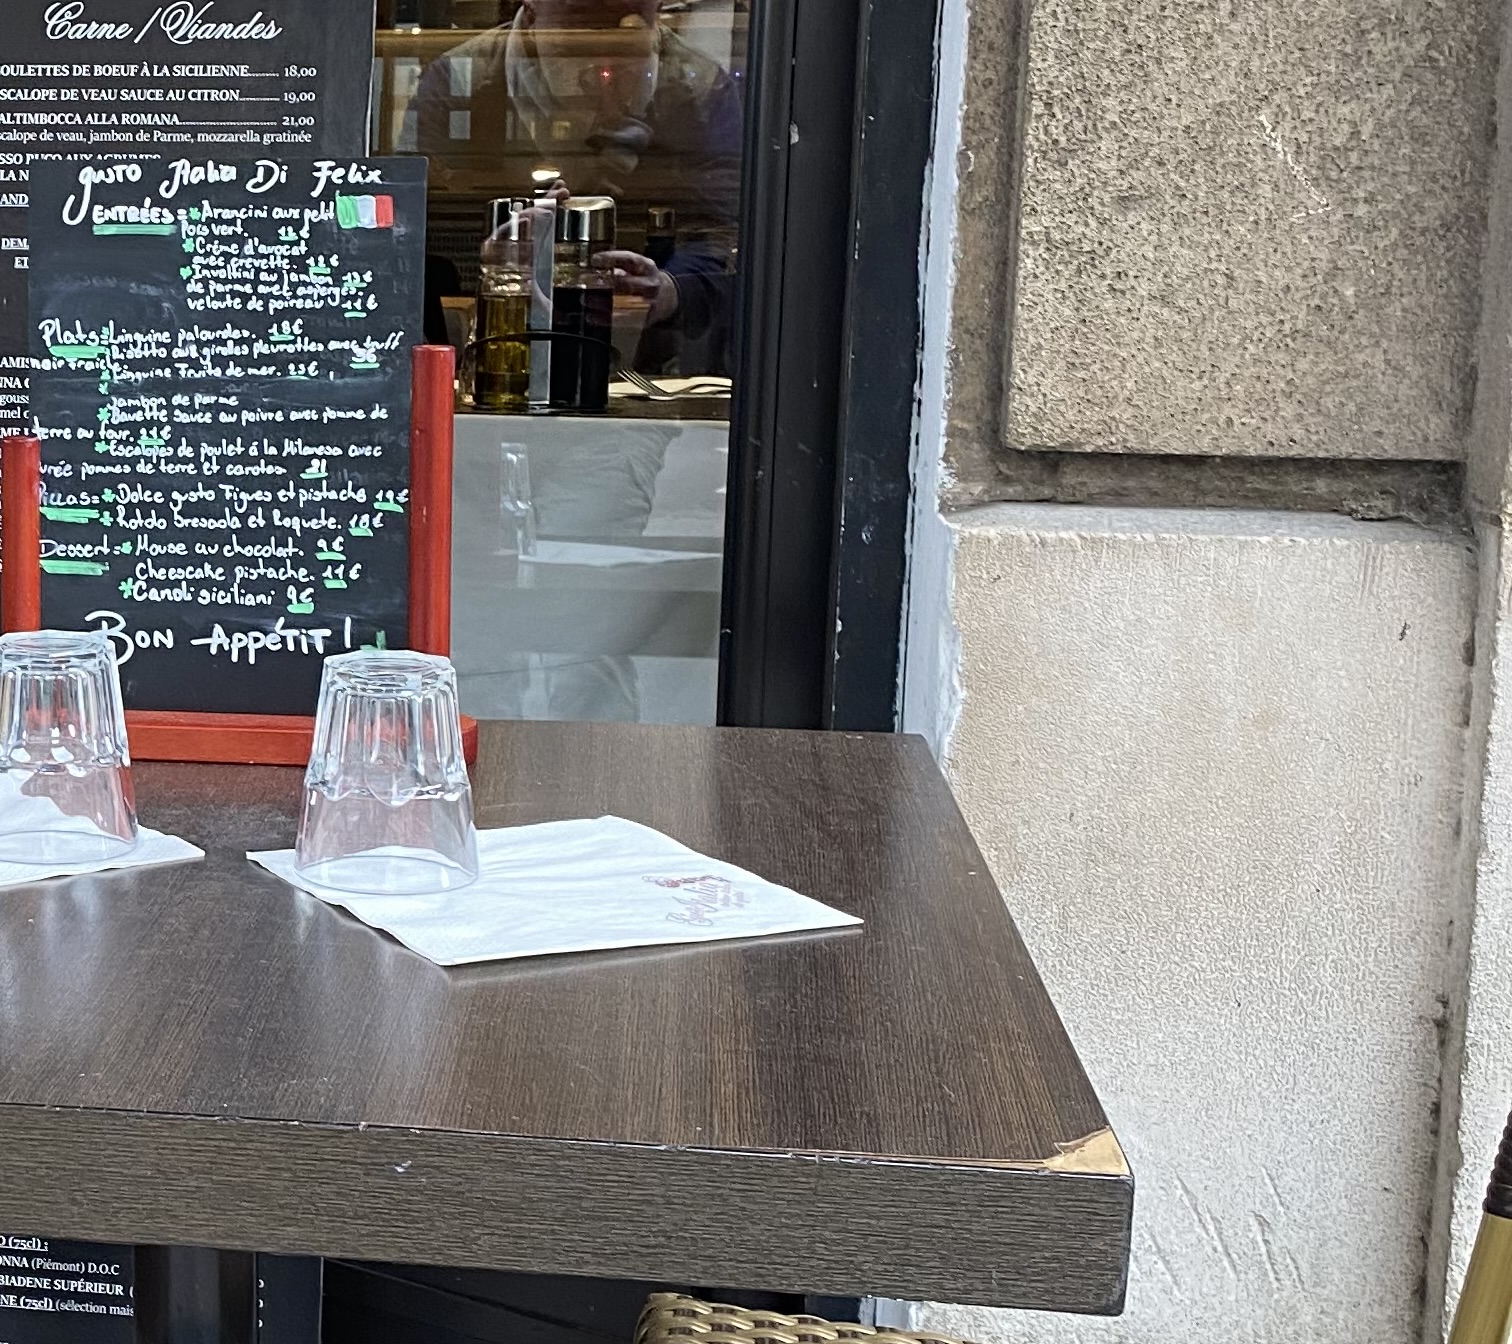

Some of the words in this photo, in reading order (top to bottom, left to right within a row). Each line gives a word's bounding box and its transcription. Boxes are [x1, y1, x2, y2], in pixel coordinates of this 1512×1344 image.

[44, 2, 134, 40] Carne
[160, 1, 282, 44] Viandes
[72, 66, 90, 77] DE
[94, 66, 138, 77] BOEUF
[140, 62, 150, 77] À
[153, 66, 170, 77] LA
[173, 65, 248, 77] SICILIENNE
[284, 67, 316, 79] 18,00
[62, 90, 79, 101] DE
[82, 89, 117, 101] VEAU
[120, 90, 163, 101] SAUCE
[166, 90, 185, 101] AU
[188, 90, 239, 101] CITRON
[283, 92, 315, 104] 19,00
[85, 114, 118, 125] ALLA
[121, 114, 179, 125] ROMANA
[282, 116, 314, 127] 21,00
[39, 130, 54, 141] de
[56, 133, 85, 143] veau,
[87, 130, 133, 145] jambon
[136, 131, 150, 142] de
[153, 131, 195, 144] Parme,
[197, 131, 260, 142] mozzarella
[263, 131, 311, 144] gratinée
[246, 159, 286, 193] Di
[202, 200, 268, 222] Arancini
[273, 206, 302, 220] aux
[247, 296, 263, 310] de
[116, 484, 164, 503] Dolce
[277, 481, 295, 502] et
[136, 539, 188, 557] Mouse
[196, 540, 218, 555] au
[9, 1237, 42, 1251] (75cl)
